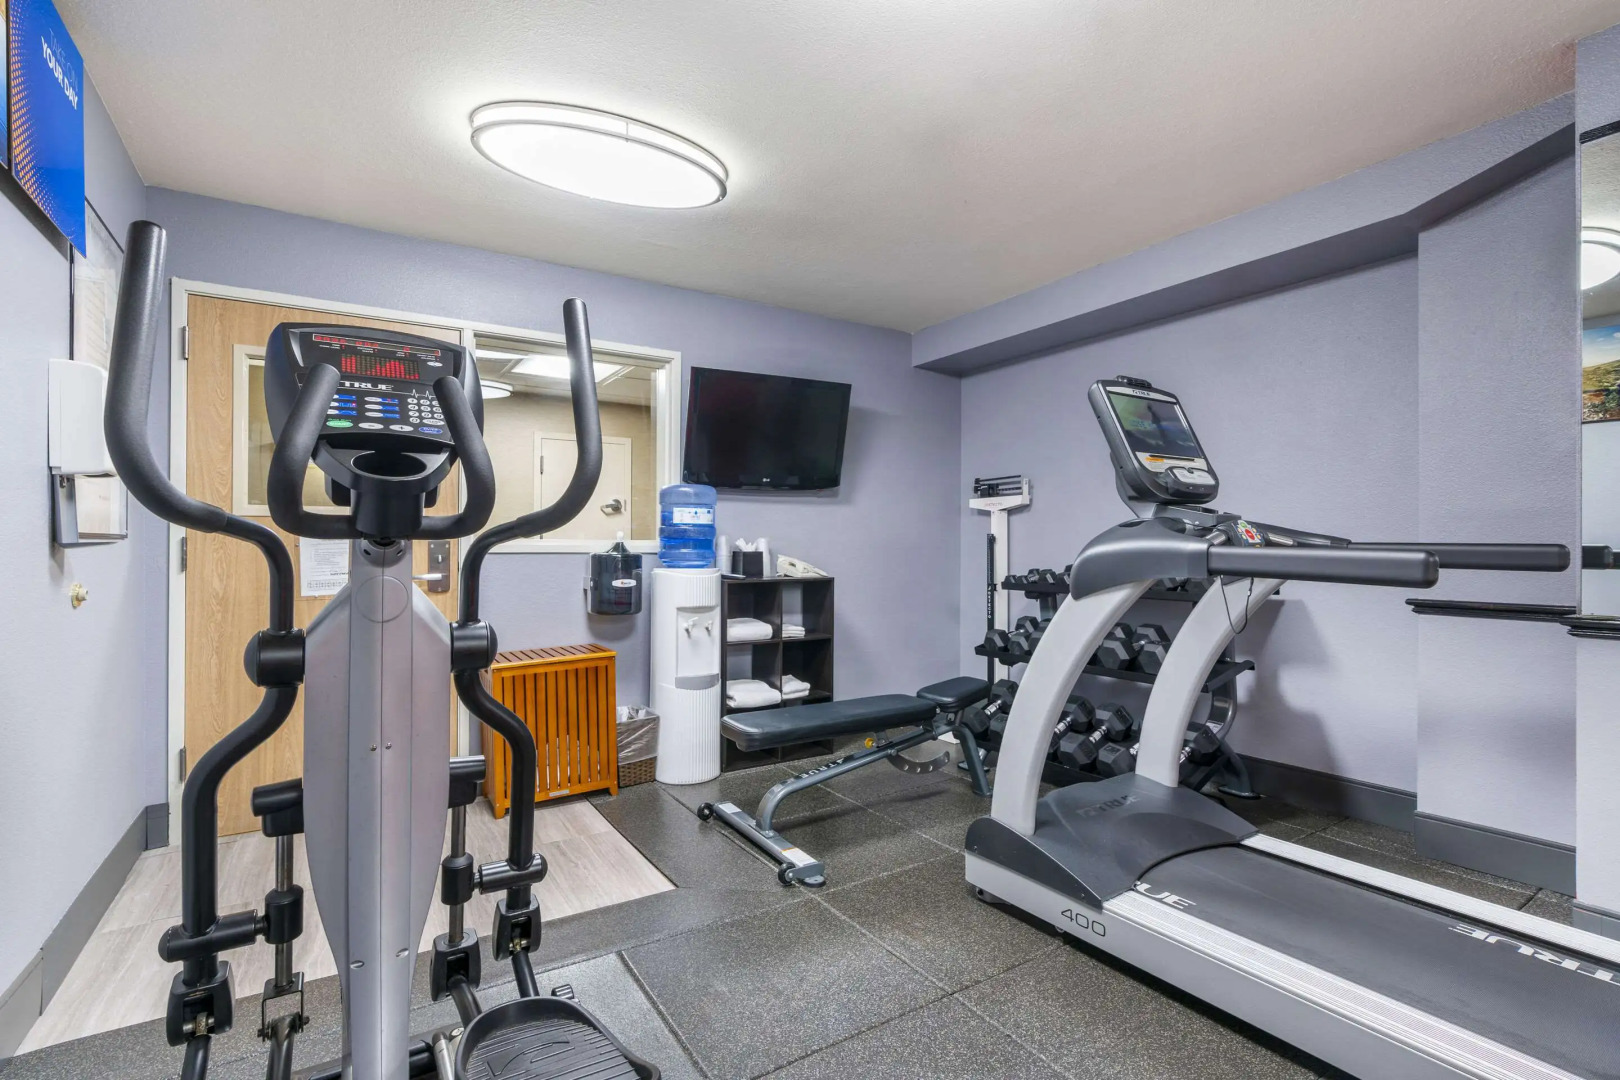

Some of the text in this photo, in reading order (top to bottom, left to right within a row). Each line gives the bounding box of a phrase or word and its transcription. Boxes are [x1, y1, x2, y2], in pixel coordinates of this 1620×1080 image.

[41, 35, 78, 110] YOUR DAY
[340, 381, 392, 391] TRUE
[799, 761, 838, 779] TRUE
[1061, 908, 1106, 937] 400
[1448, 923, 1620, 986] TRUE
